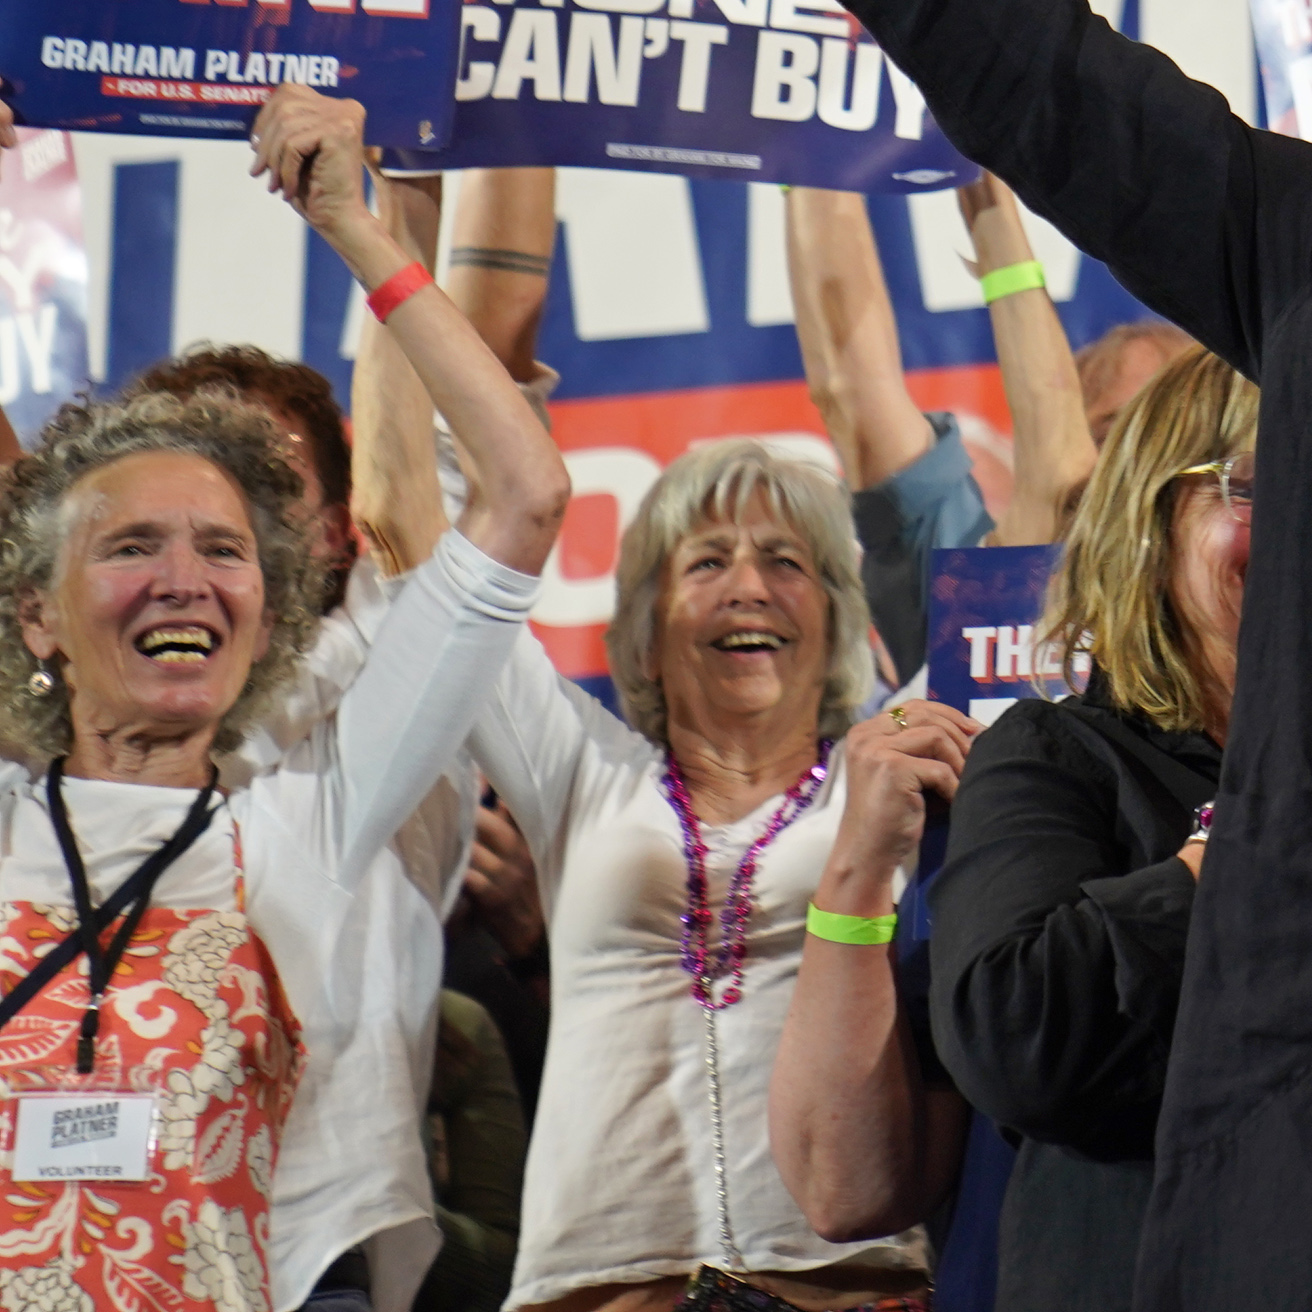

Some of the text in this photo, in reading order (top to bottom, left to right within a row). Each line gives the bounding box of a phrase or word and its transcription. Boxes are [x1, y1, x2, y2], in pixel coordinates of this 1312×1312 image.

[41, 35, 340, 88] GRAHAM PLATNER
[456, 5, 928, 141] CAN'T BUY
[117, 79, 158, 96] FOR
[53, 1101, 119, 1125] GRAHAM
[52, 1116, 118, 1140] PLATNER
[38, 1165, 123, 1177] VOLUNTEER
